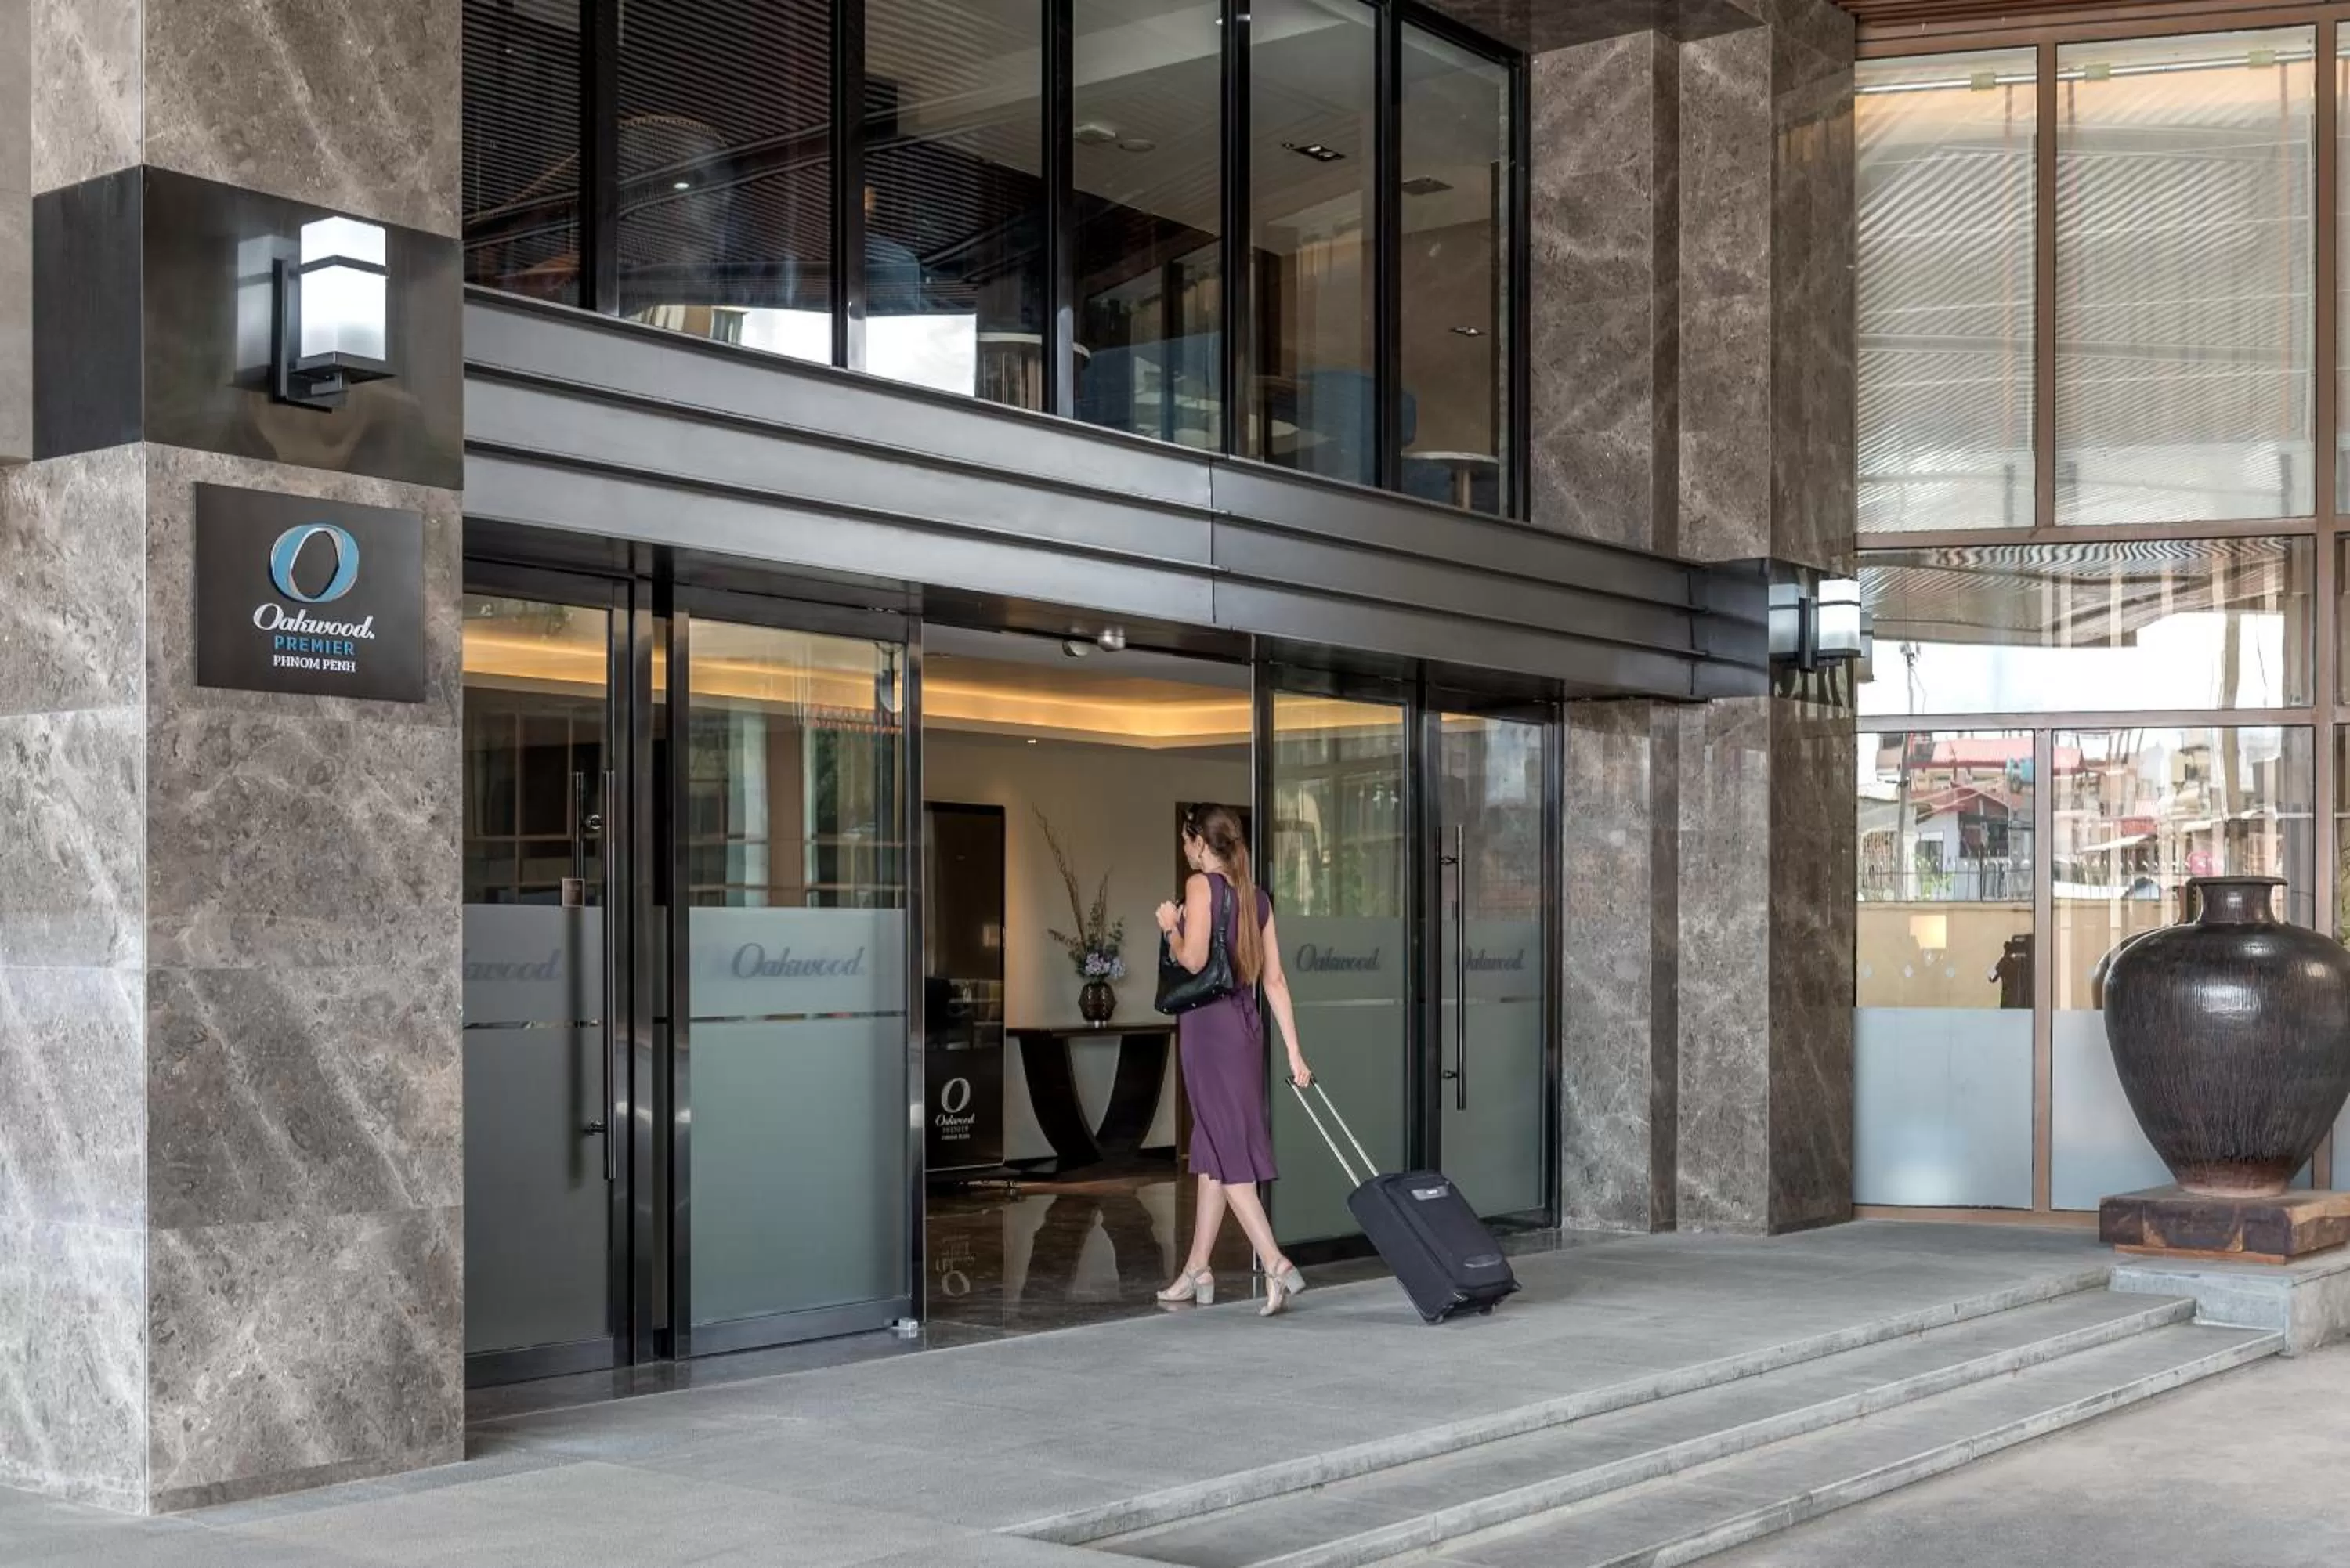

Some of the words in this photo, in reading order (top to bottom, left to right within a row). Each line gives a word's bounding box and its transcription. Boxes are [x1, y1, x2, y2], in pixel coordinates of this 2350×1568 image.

[274, 635, 355, 656] PREMIER
[273, 654, 320, 670] PHNOM
[322, 659, 356, 672] PENH
